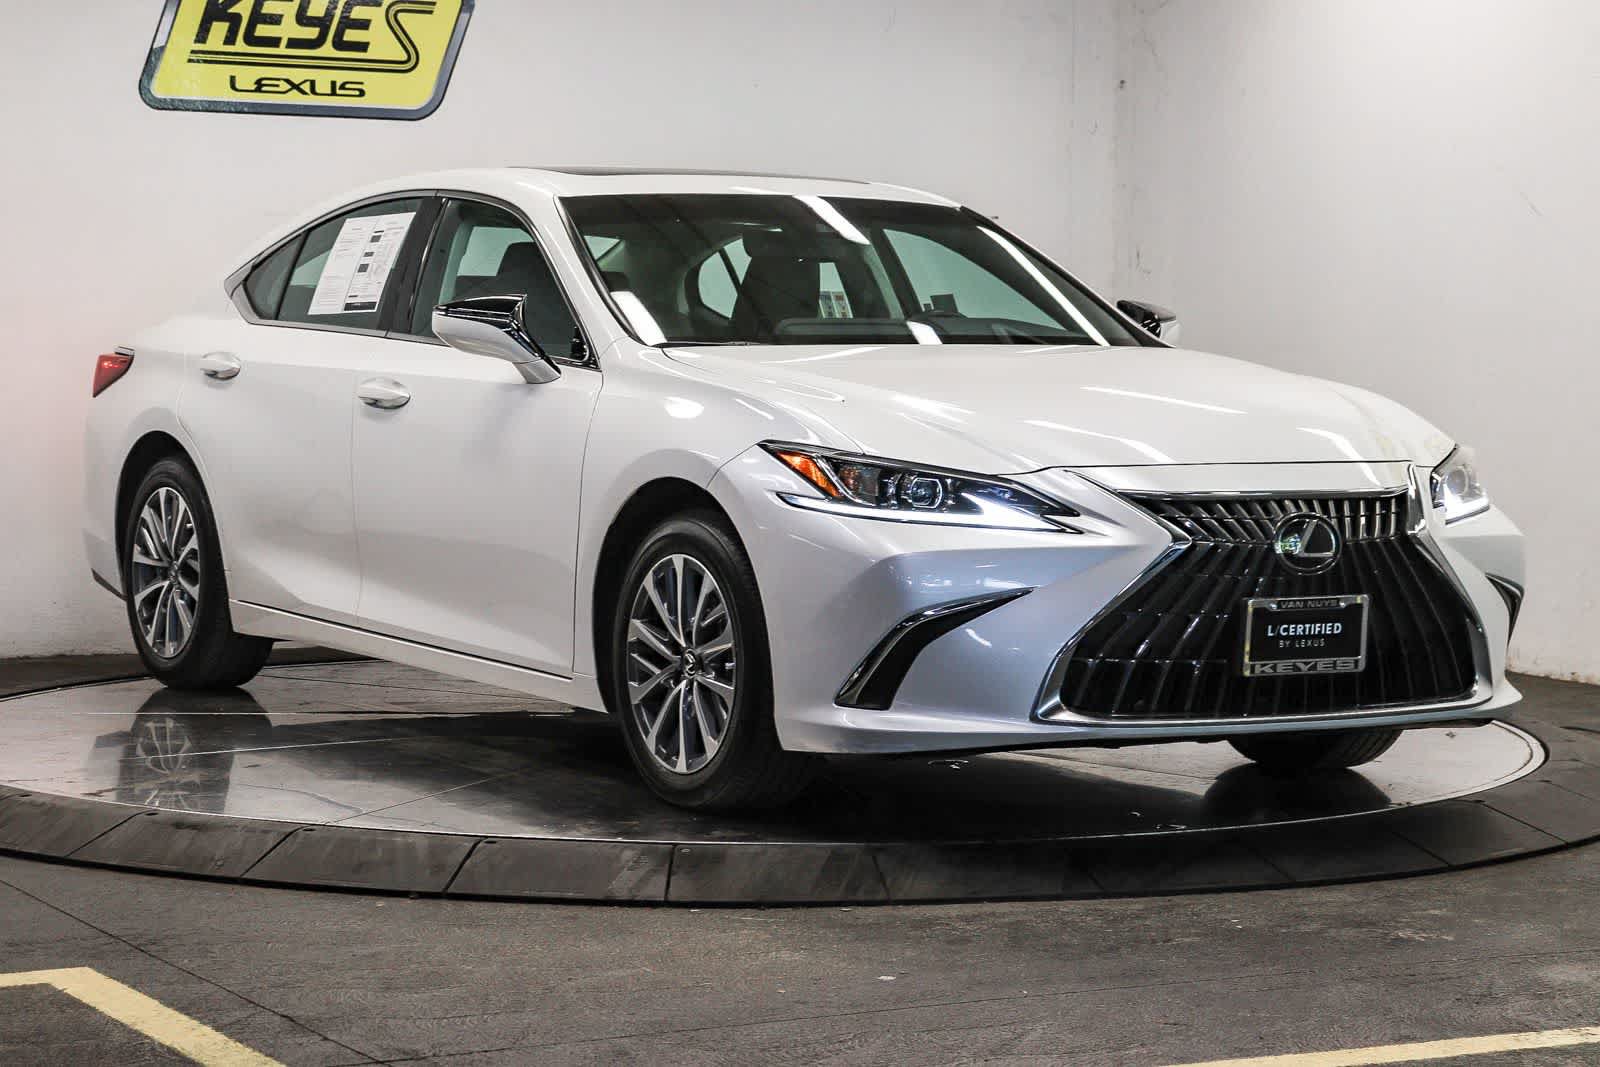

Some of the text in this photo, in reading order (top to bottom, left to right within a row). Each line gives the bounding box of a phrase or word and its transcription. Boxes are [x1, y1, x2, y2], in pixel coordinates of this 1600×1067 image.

[190, 0, 437, 73] KEYES
[229, 75, 366, 98] LEXUS
[1280, 599, 1338, 609] VAN NUYS
[1279, 638, 1326, 648] BY LEXUS
[1254, 660, 1355, 674] KEYES
